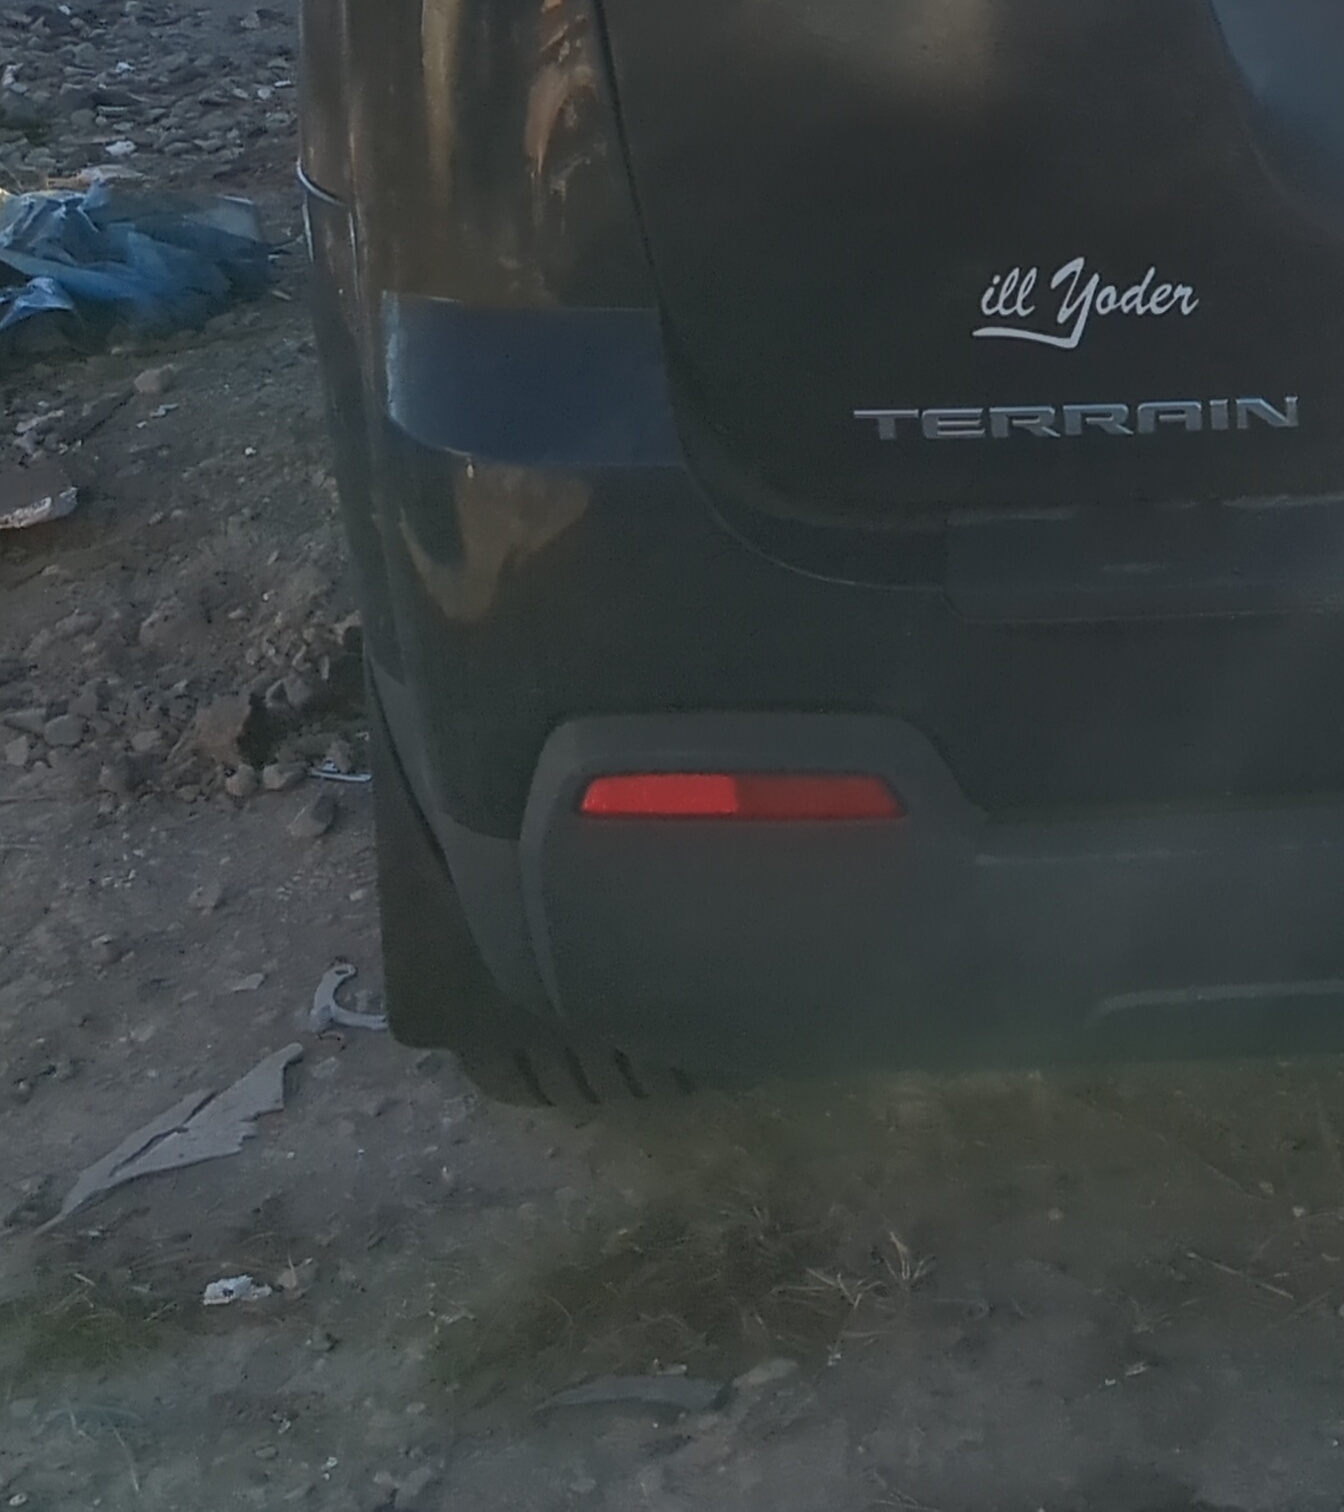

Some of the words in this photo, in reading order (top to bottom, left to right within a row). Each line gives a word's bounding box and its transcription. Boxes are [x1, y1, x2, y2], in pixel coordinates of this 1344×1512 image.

[980, 266, 1036, 317] ill
[1048, 256, 1200, 350] Yoder
[853, 395, 1300, 441] TERRAIN
